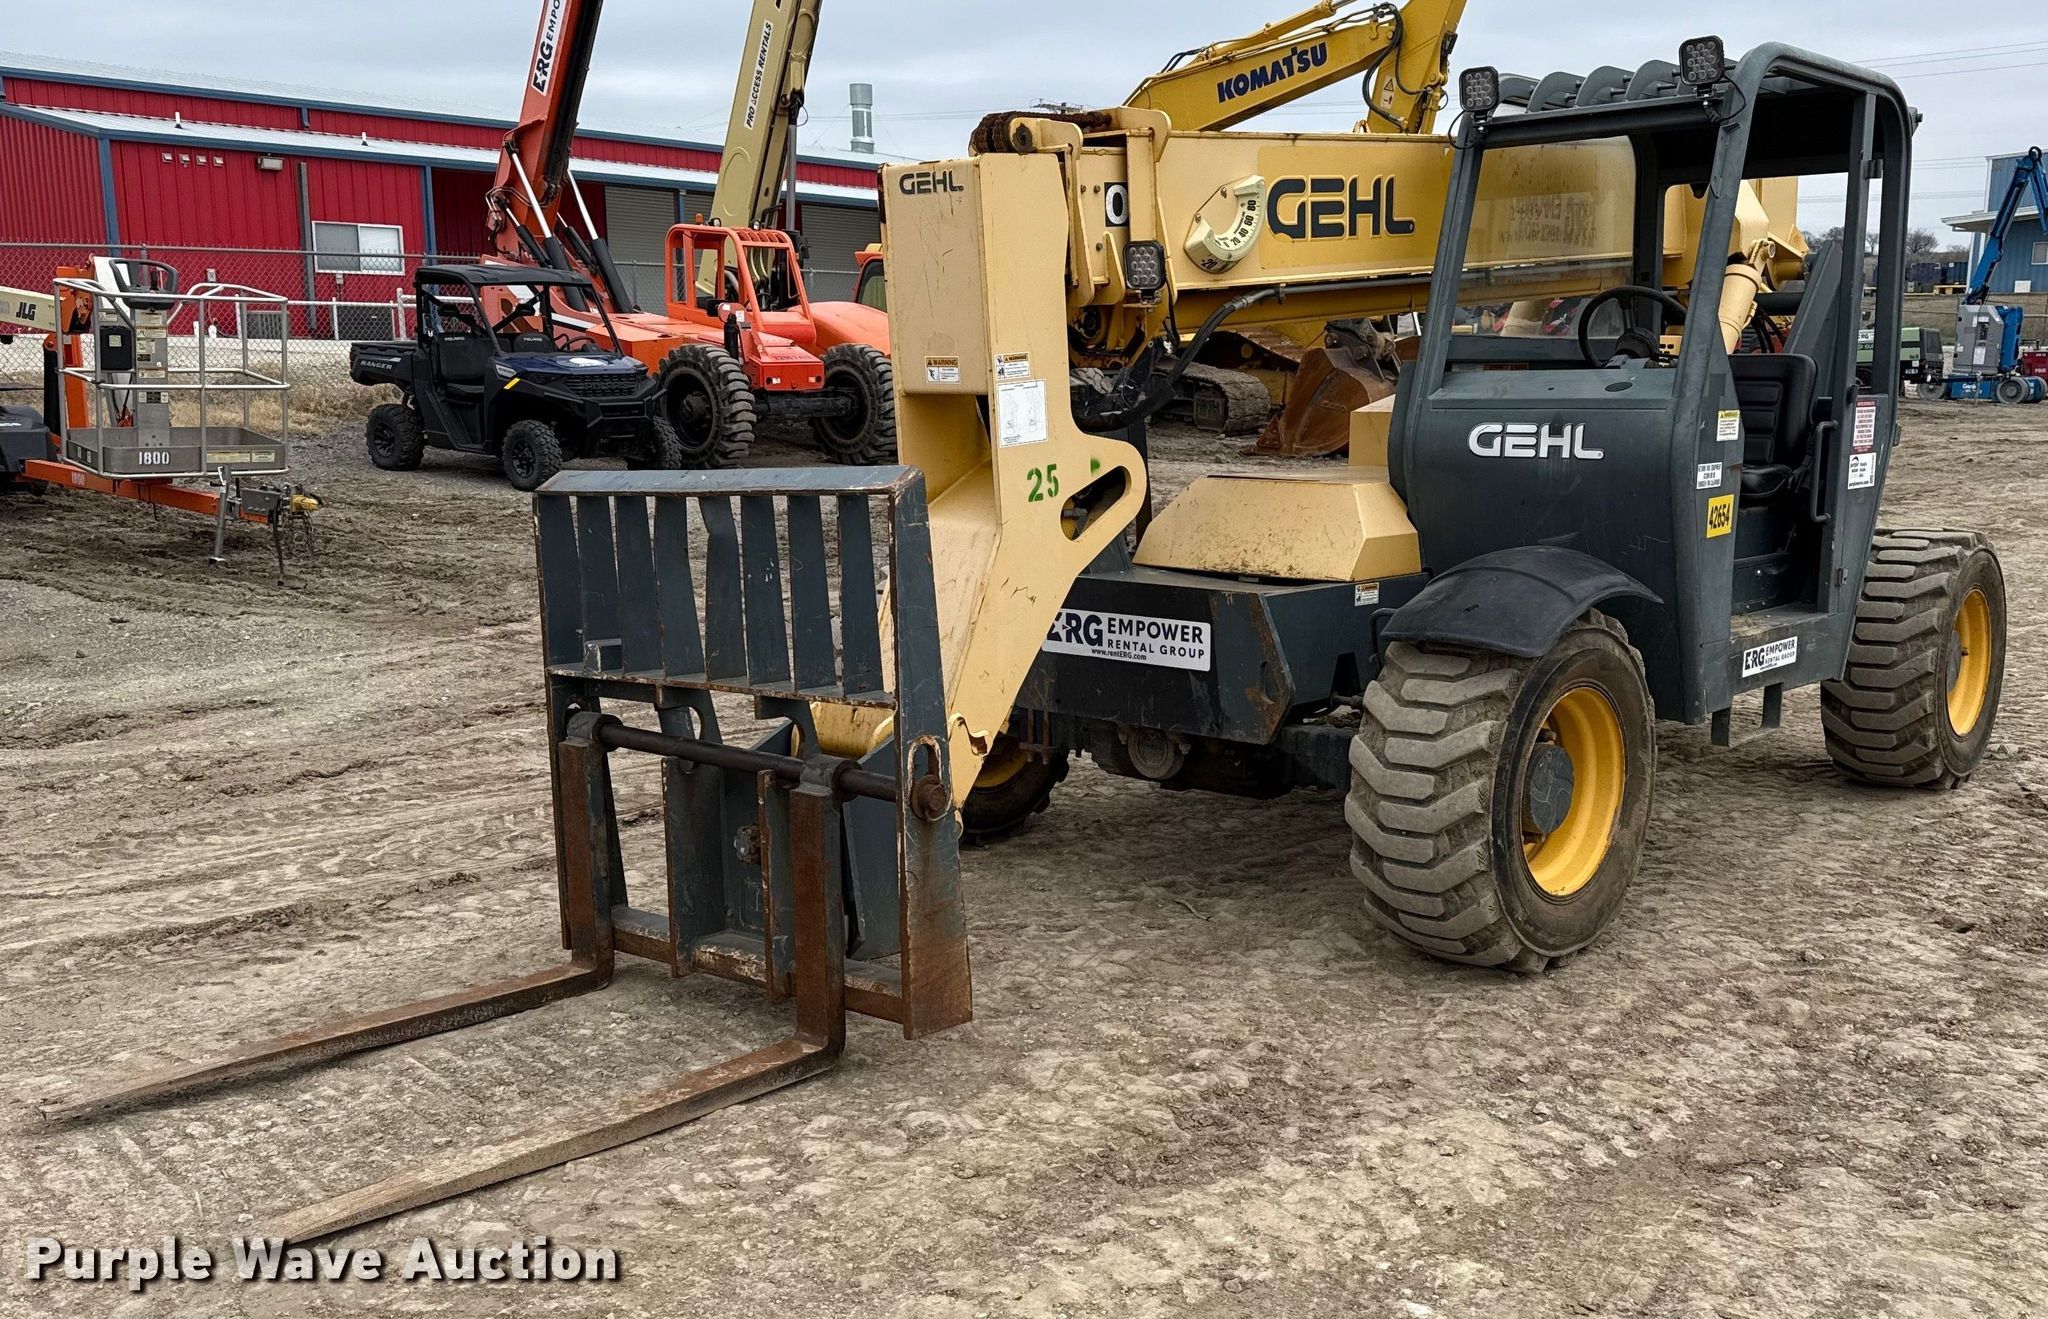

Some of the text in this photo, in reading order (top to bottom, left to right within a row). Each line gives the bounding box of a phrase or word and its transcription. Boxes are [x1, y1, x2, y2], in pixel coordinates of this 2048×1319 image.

[533, 41, 553, 92] ERG
[746, 22, 772, 128] PRO ACCESS RENTALS
[1217, 42, 1327, 103] KOMATSU
[899, 170, 964, 194] GEHL
[1247, 200, 1256, 211] 80
[1267, 175, 1415, 239] GEHL
[1243, 215, 1254, 226] 60
[1230, 237, 1241, 246] 20
[1239, 228, 1249, 238] 40
[16, 301, 36, 321] JLG
[360, 360, 393, 371] RANGER
[1469, 422, 1604, 459] GEHL
[138, 451, 170, 465] 1800
[1027, 464, 1059, 502] 25
[1708, 503, 1731, 530] 42654
[1107, 617, 1204, 644] EMPOWER
[1091, 648, 1147, 660] www.rentERG.com
[1107, 638, 1205, 659] RENTAL GROUP
[1745, 639, 1795, 670] ERG EMPOWER
